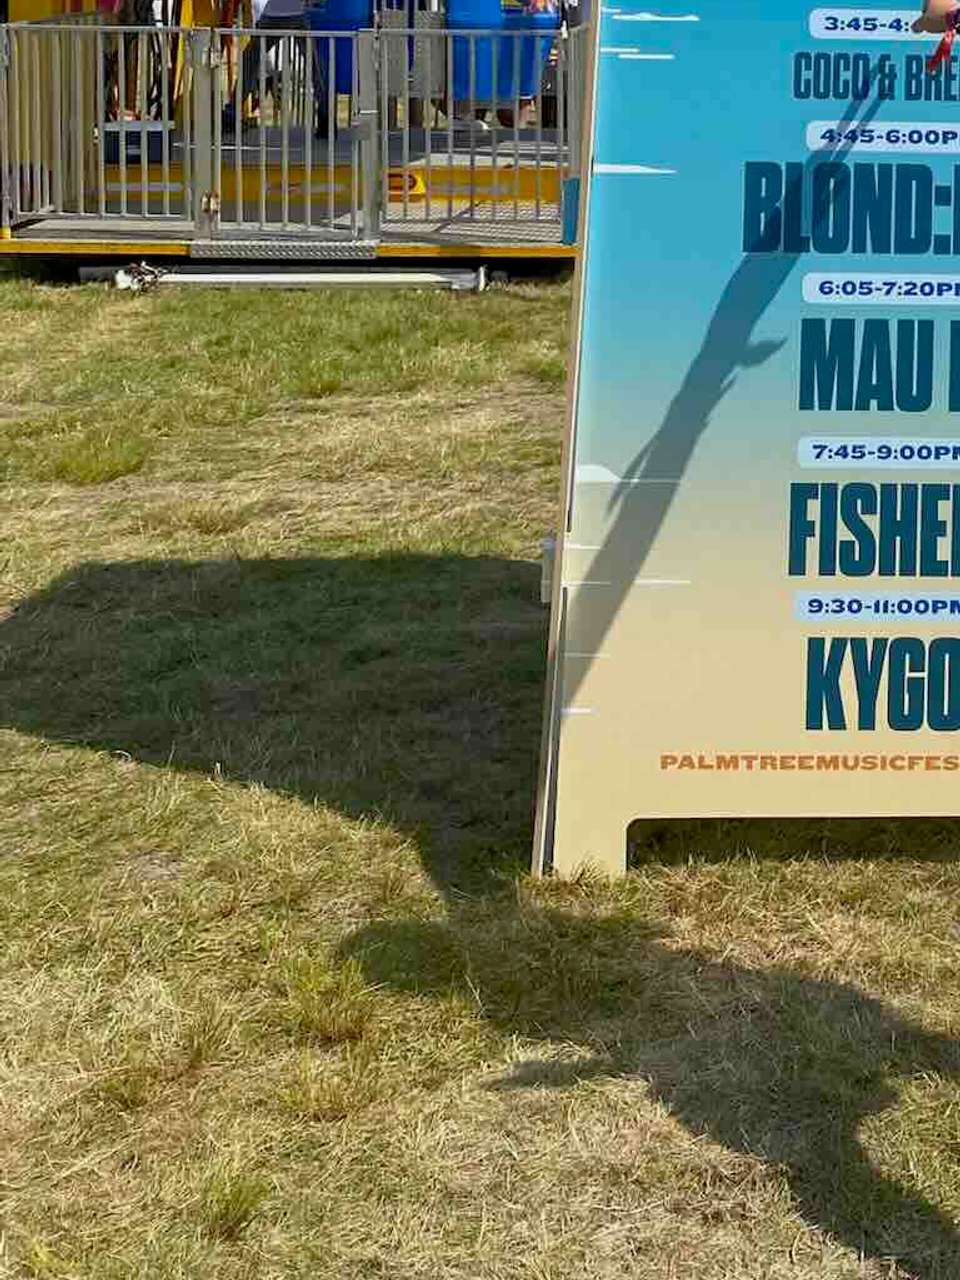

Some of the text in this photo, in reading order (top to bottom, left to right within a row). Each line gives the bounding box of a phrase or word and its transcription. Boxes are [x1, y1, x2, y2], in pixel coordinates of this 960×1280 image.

[824, 16, 911, 32] 3:45-4:
[793, 52, 870, 100] COCO
[877, 54, 897, 100] &
[798, 320, 934, 411] MAU
